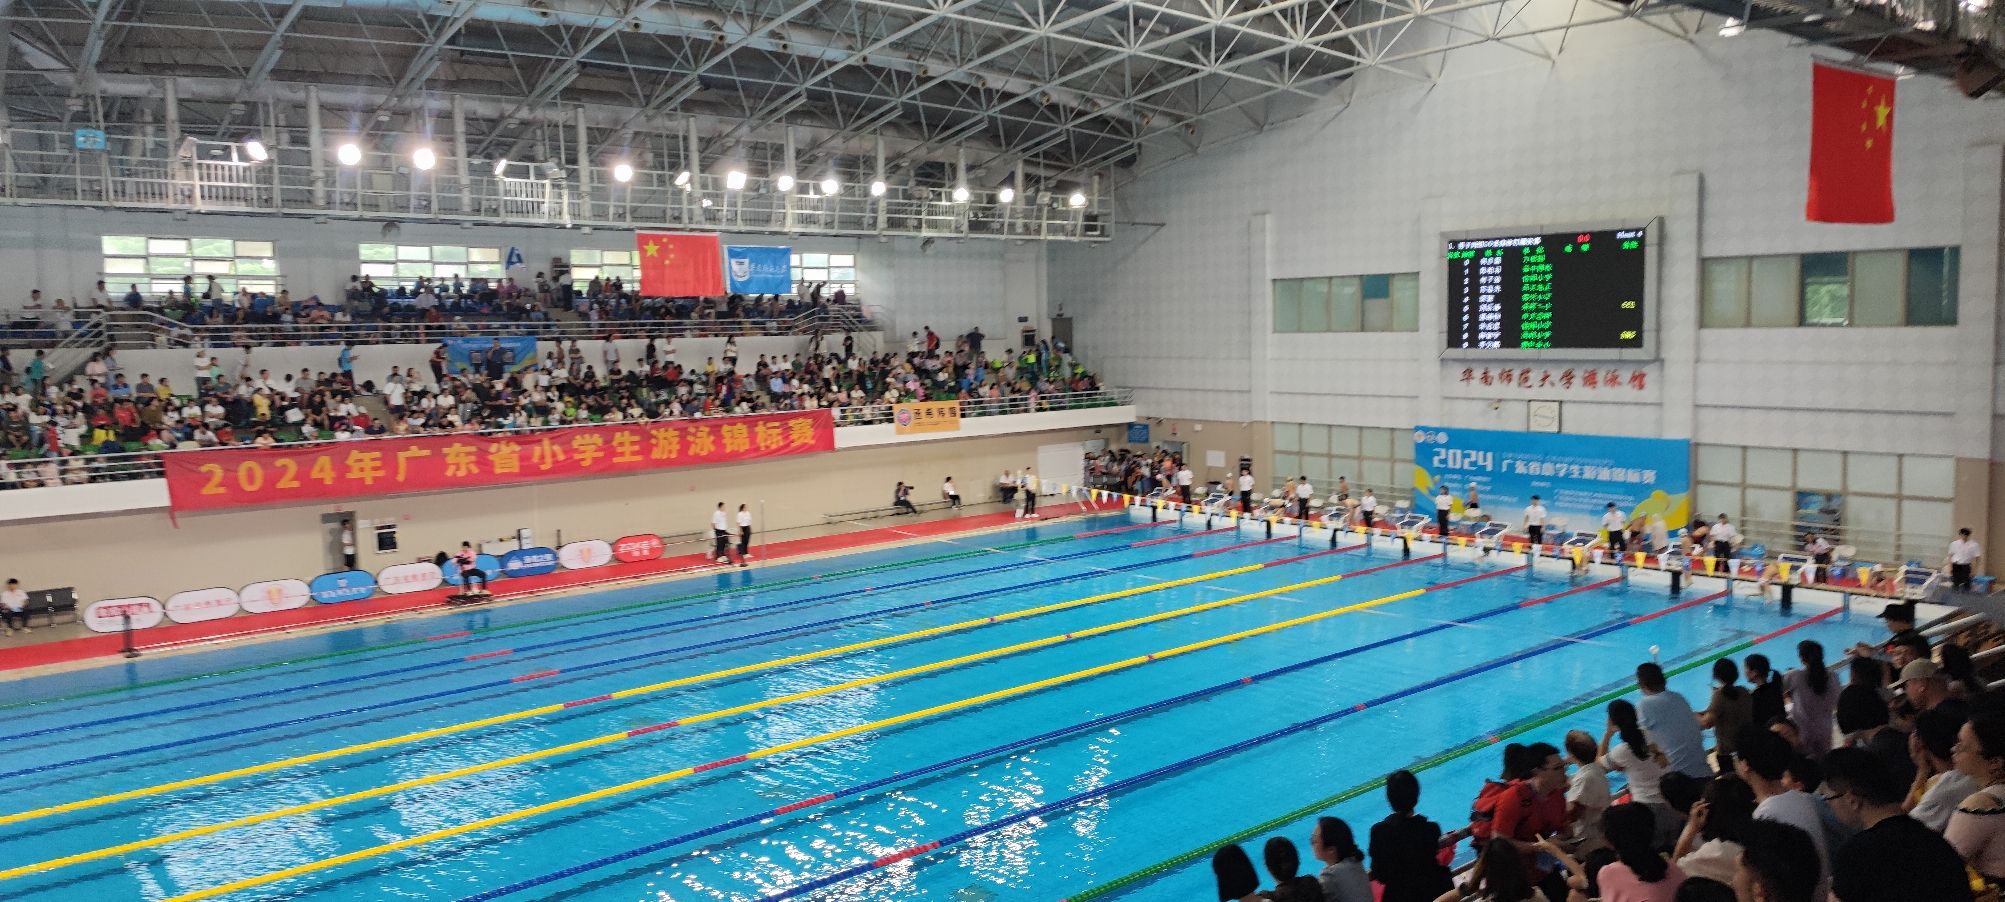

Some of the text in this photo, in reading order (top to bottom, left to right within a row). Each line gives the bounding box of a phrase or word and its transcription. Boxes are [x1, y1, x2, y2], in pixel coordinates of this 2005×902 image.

[1460, 367, 1648, 389] 华南师范大学游泳馆
[199, 417, 817, 496] 2024年广东省小学生游泳锦标赛
[1432, 447, 1494, 472] 2024
